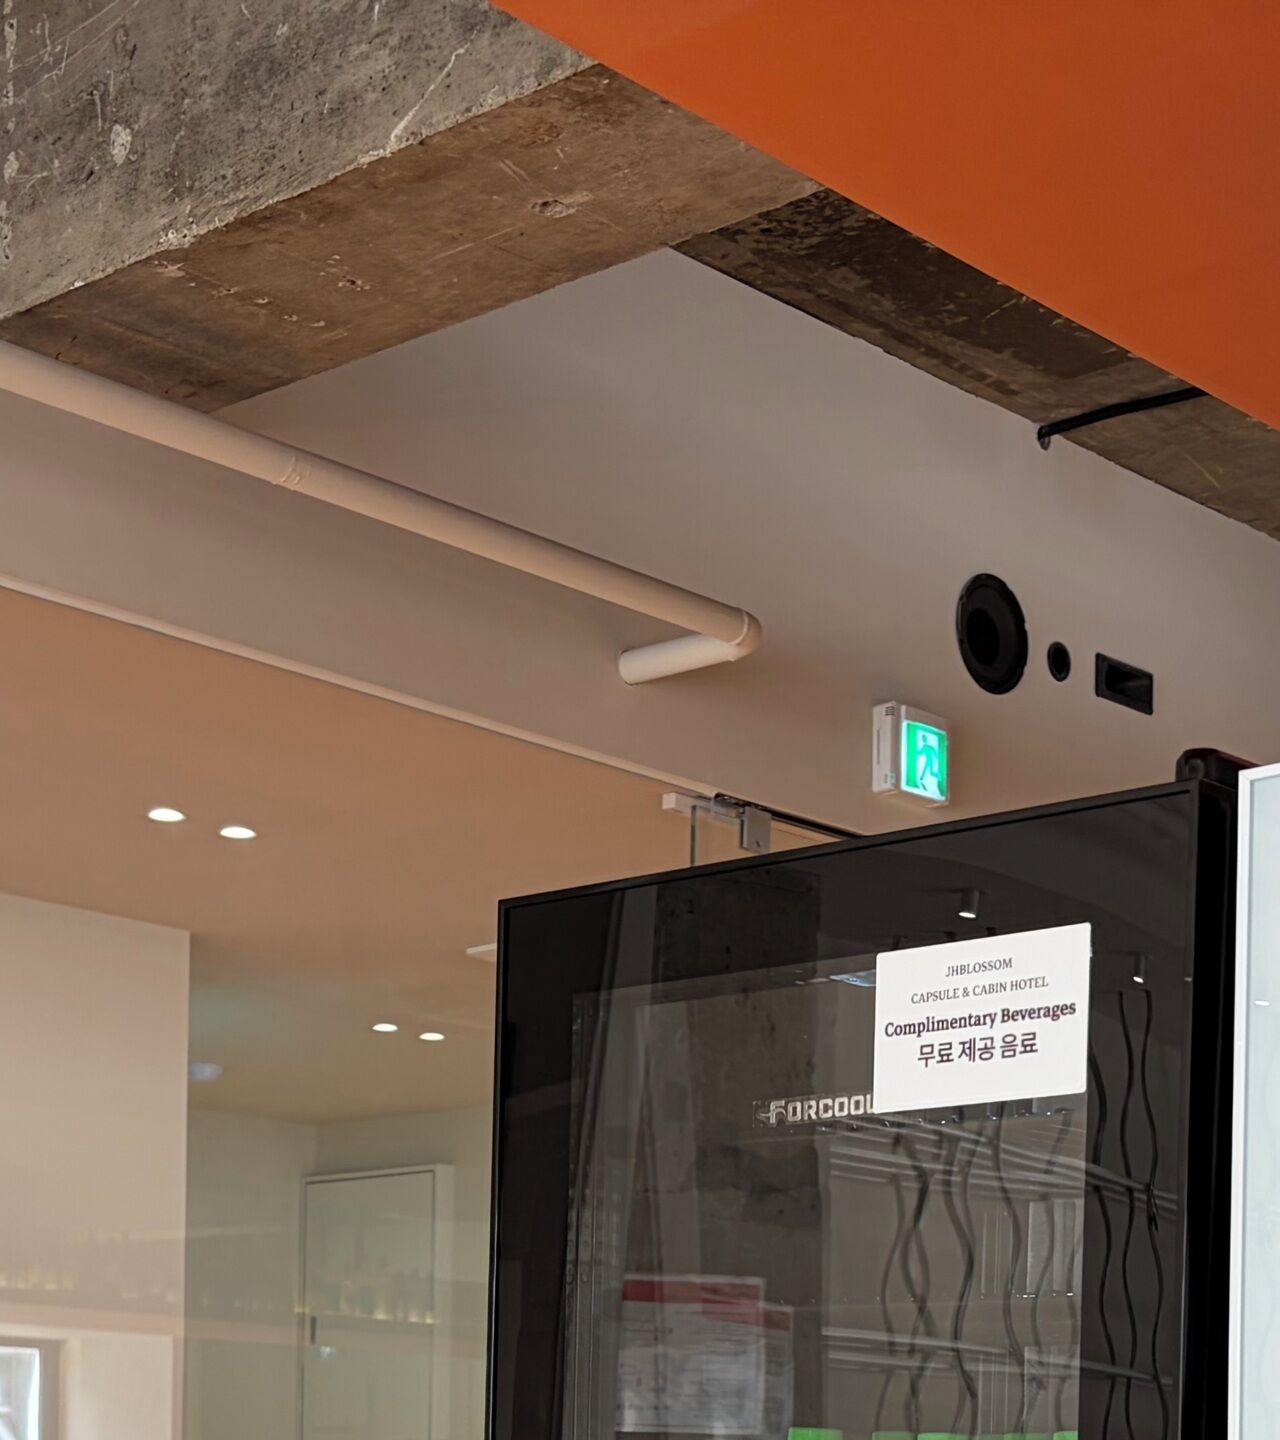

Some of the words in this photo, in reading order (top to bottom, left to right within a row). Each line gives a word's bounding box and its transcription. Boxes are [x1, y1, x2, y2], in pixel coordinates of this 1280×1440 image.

[945, 957, 1014, 978] JHBLOSSOM
[910, 986, 961, 1005] CAPSULE
[962, 985, 971, 999] &
[972, 980, 1008, 998] CABIN
[1010, 975, 1049, 993] HOTEL
[884, 1010, 998, 1038] Complimentary
[1000, 1000, 1077, 1025] Beverages
[917, 1040, 955, 1069] 무료
[957, 1036, 996, 1064] 제공
[1000, 1032, 1039, 1060] 음료
